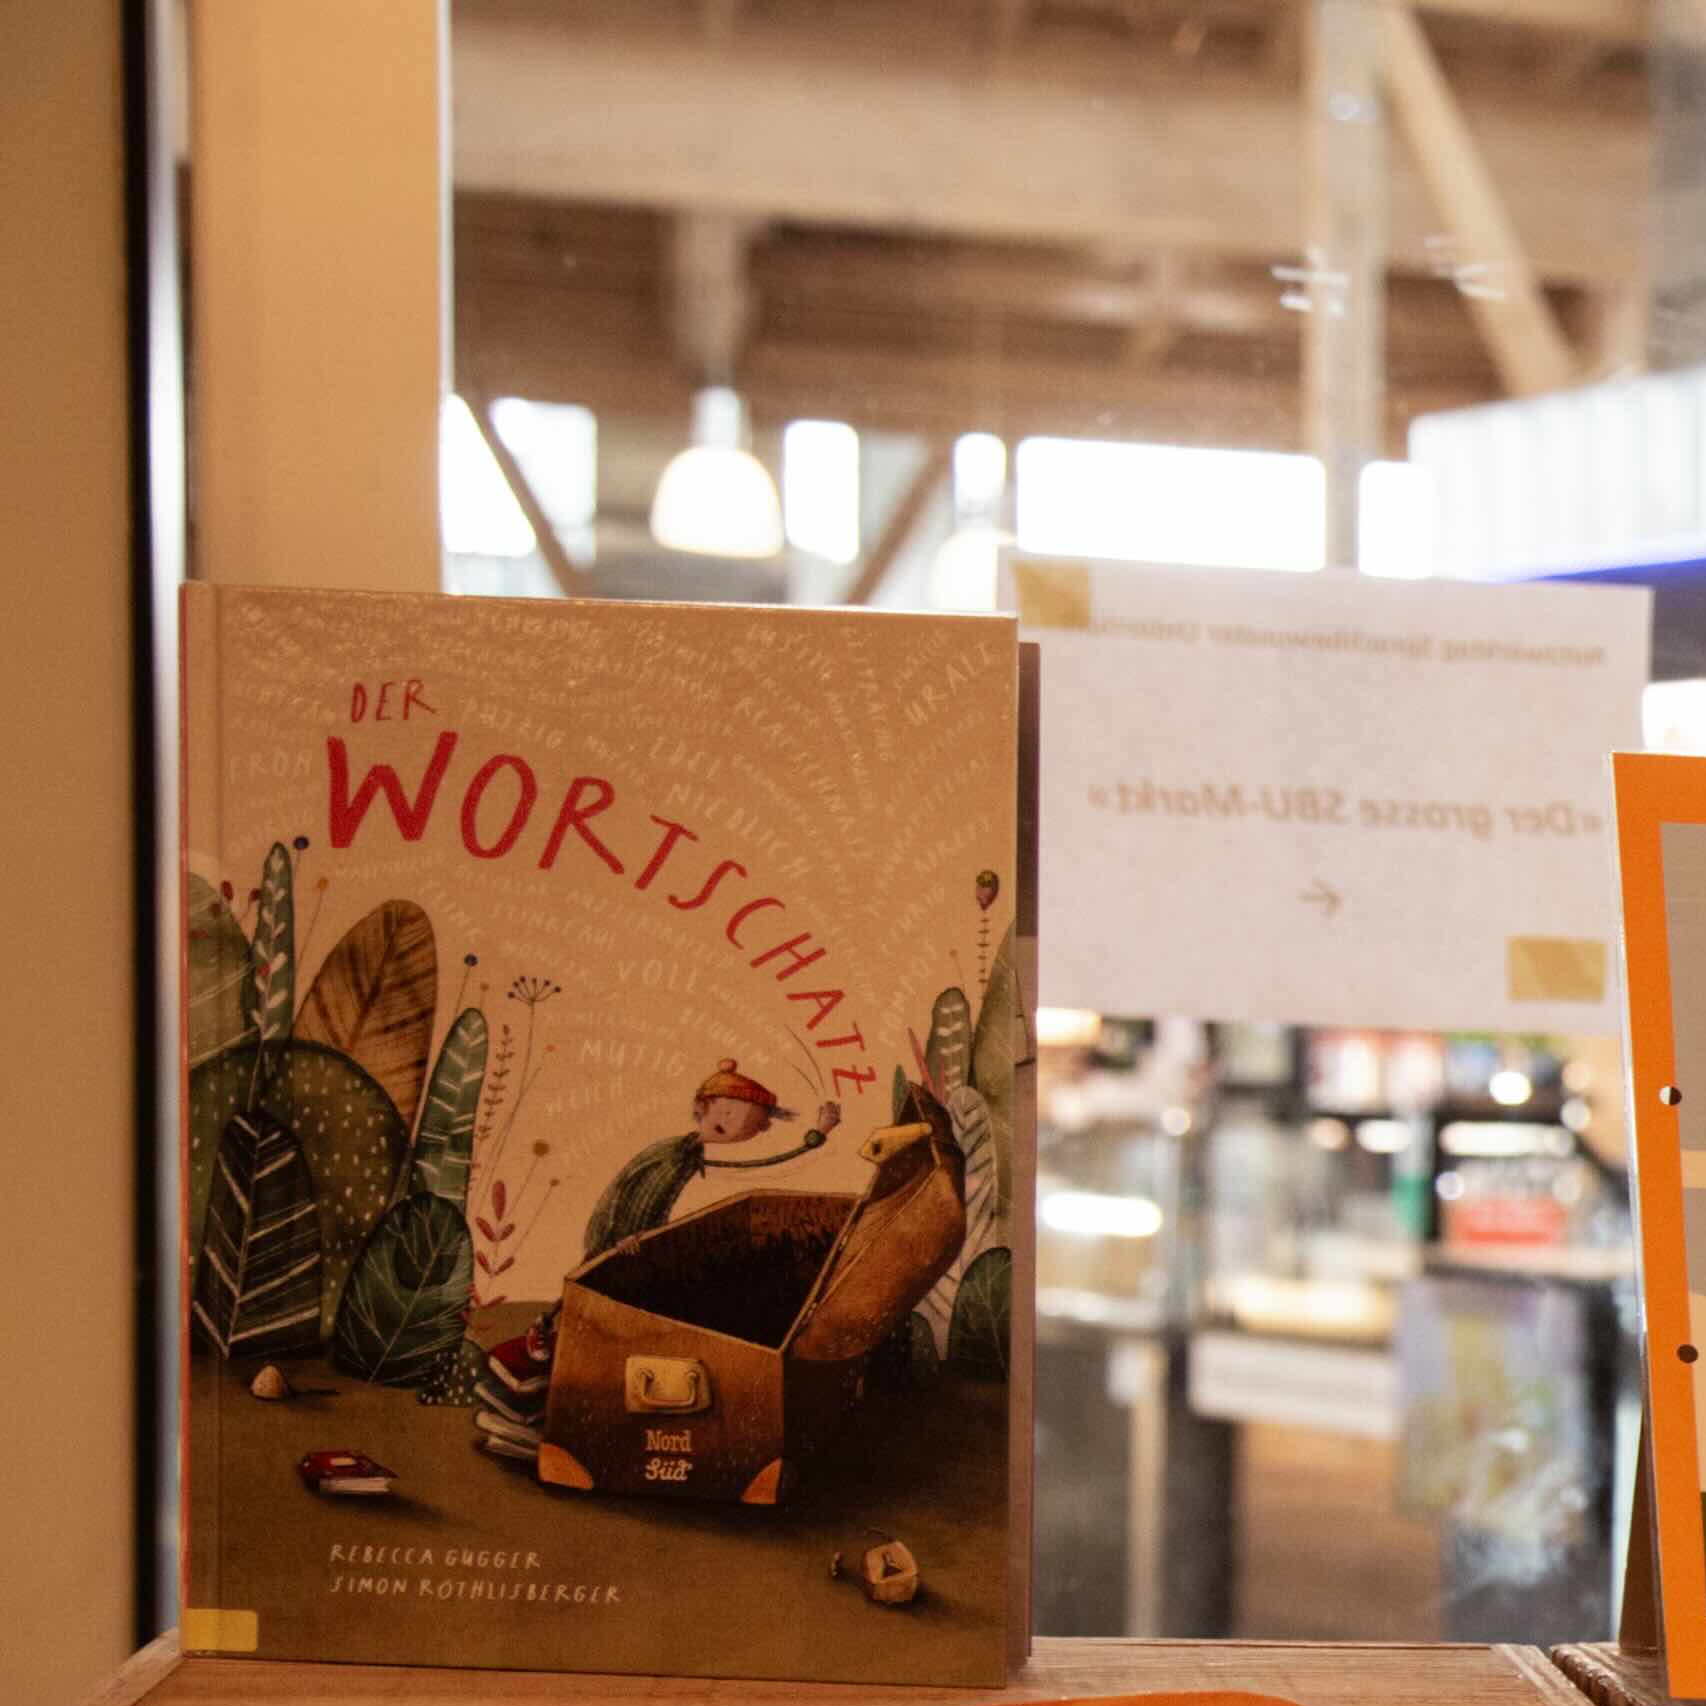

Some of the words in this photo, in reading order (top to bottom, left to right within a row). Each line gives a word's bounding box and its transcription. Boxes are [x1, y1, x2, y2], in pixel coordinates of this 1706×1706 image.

[350, 677, 438, 723] DER
[326, 730, 877, 1099] WORTSCHATZ
[616, 958, 699, 994] VOLL
[577, 1039, 689, 1077] MUTIG
[644, 1429, 693, 1455] Nord
[644, 1458, 694, 1484] Süd
[329, 1544, 434, 1566] REBECCA
[444, 1549, 542, 1570] GUGGER
[329, 1576, 409, 1595] SIMON
